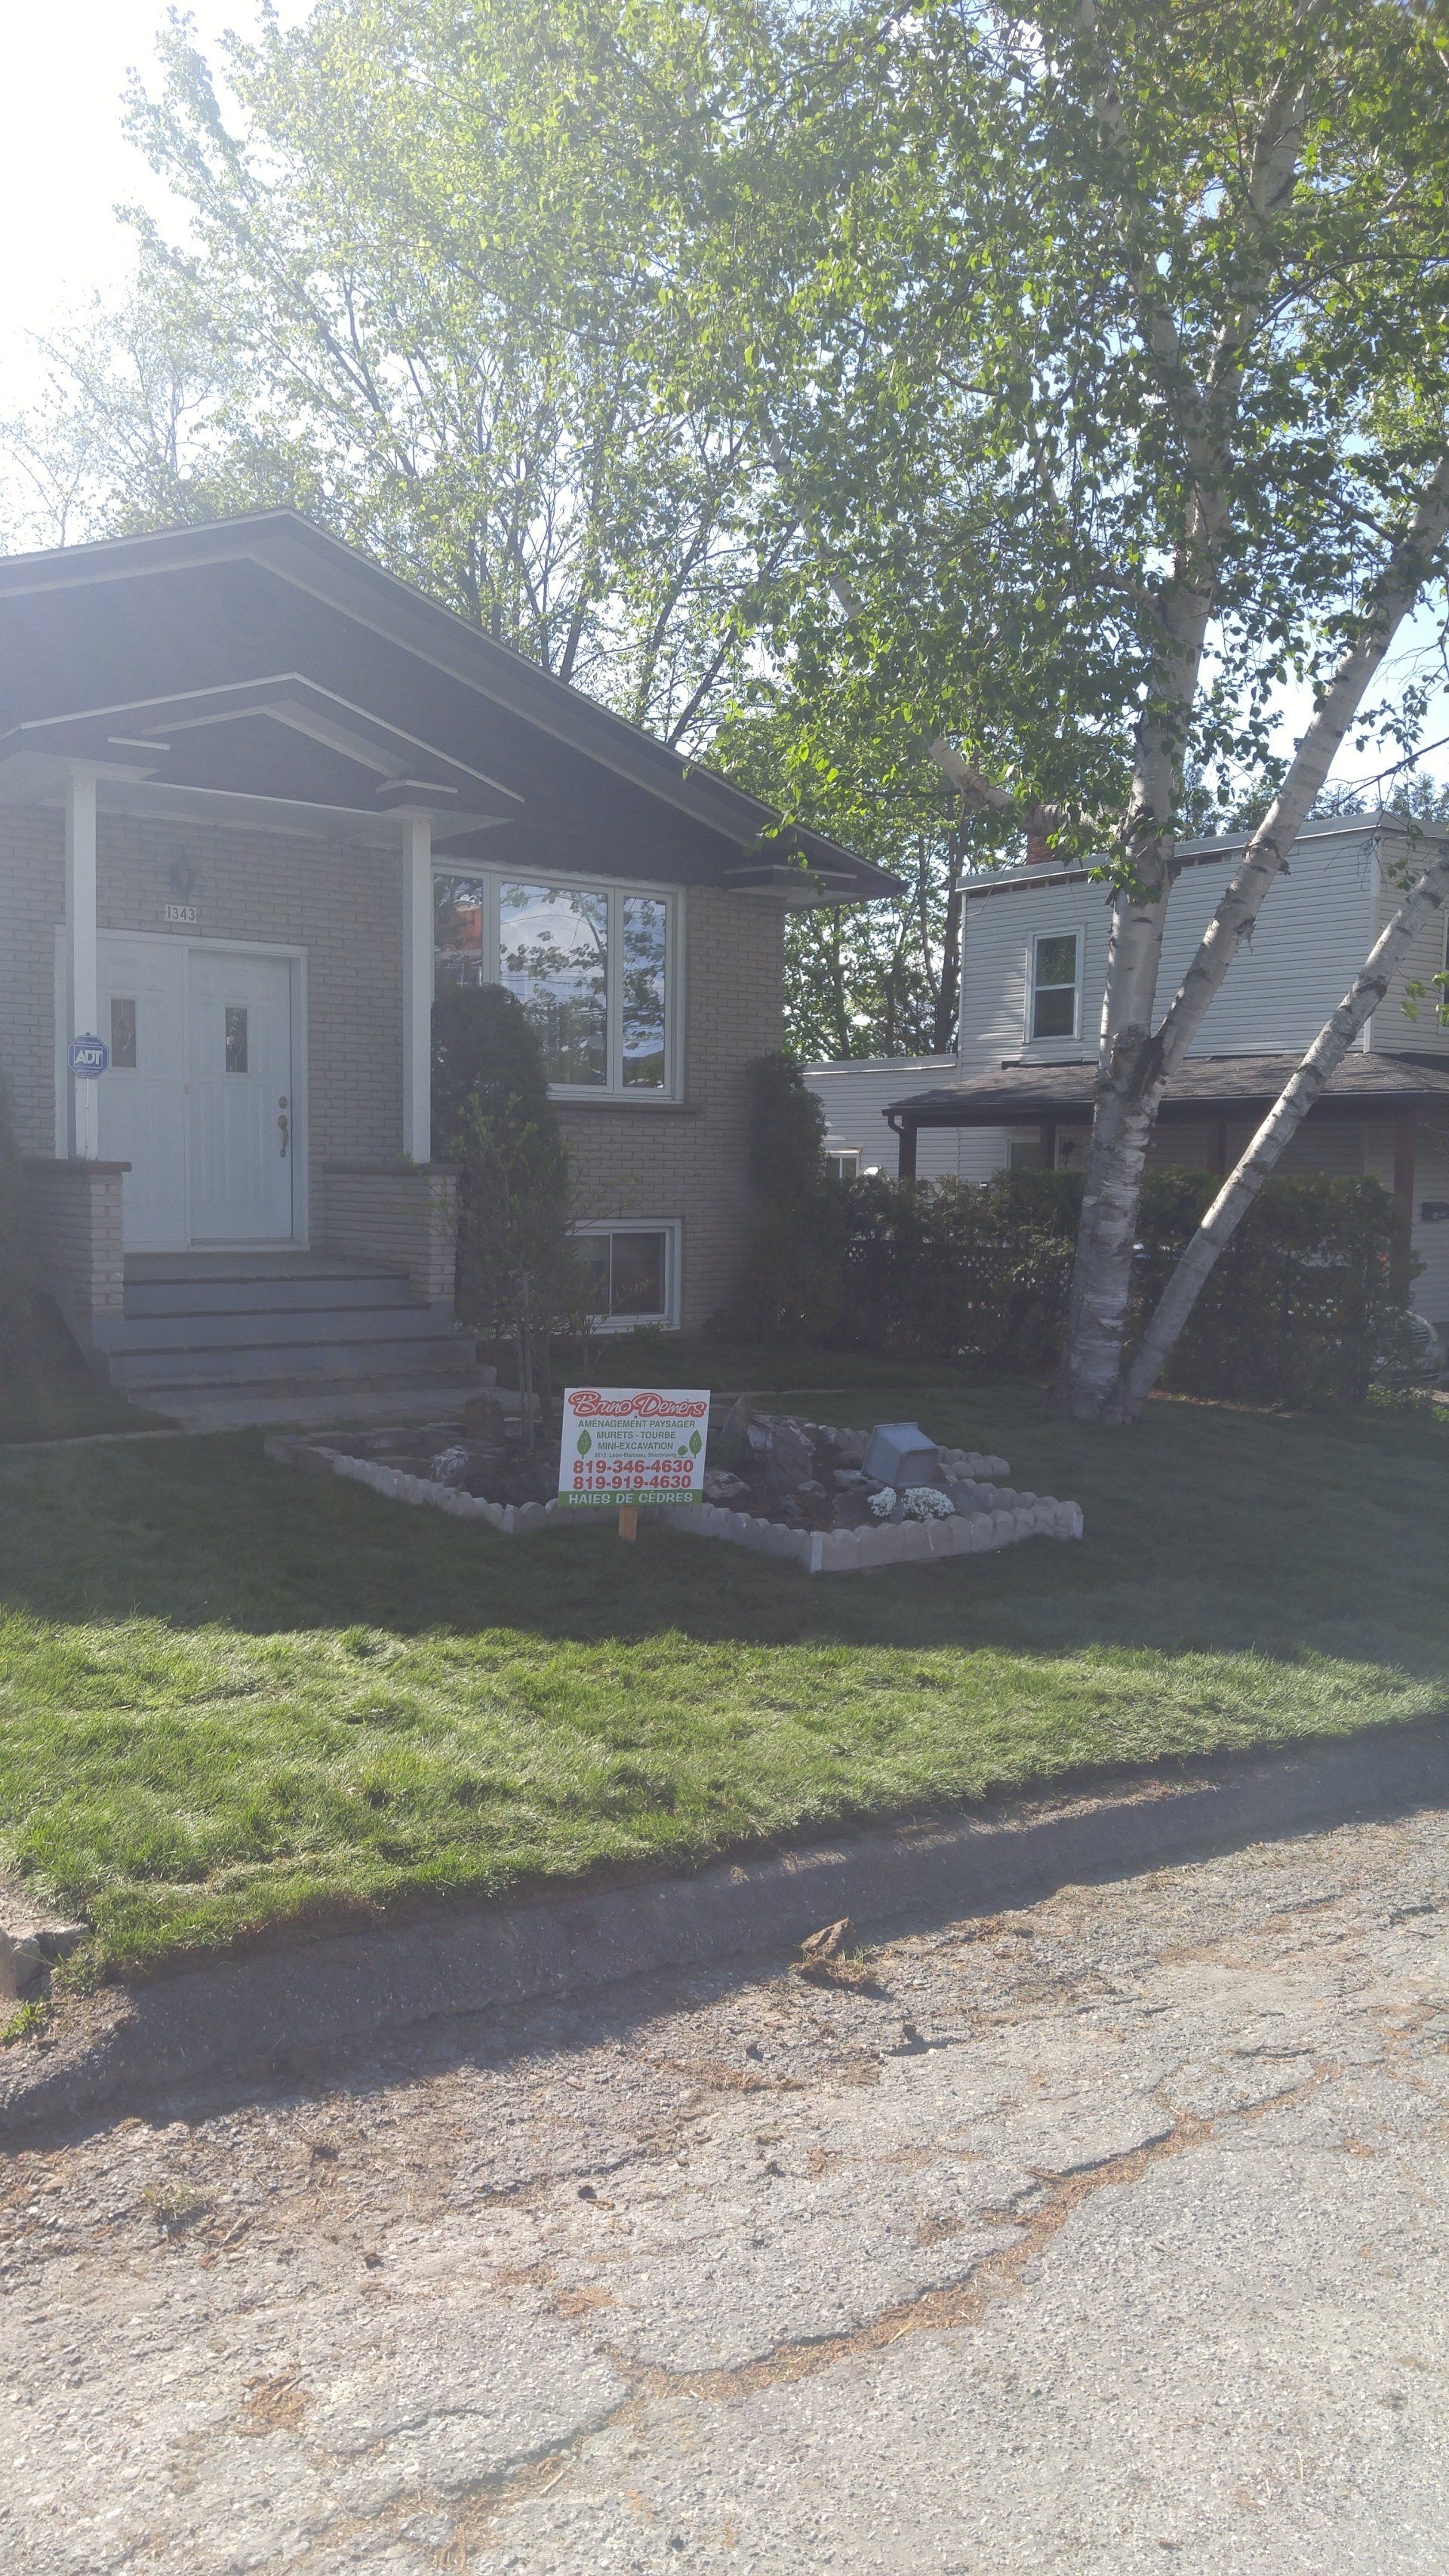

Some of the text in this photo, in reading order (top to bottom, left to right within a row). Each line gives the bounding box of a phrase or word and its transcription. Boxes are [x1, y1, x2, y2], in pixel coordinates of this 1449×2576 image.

[168, 906, 195, 921] 1343
[75, 1049, 103, 1064] ADT
[568, 1391, 707, 1417] Bruno Demers
[578, 1418, 648, 1428] AMÉNAGEMENT
[596, 1431, 634, 1439] MURETS
[598, 1442, 673, 1450] MINI-EXCAVATION
[574, 1459, 694, 1473] 819-346-4630
[574, 1475, 691, 1490] 819-919-4630
[568, 1491, 693, 1504] HAIES DE CÈDRES
